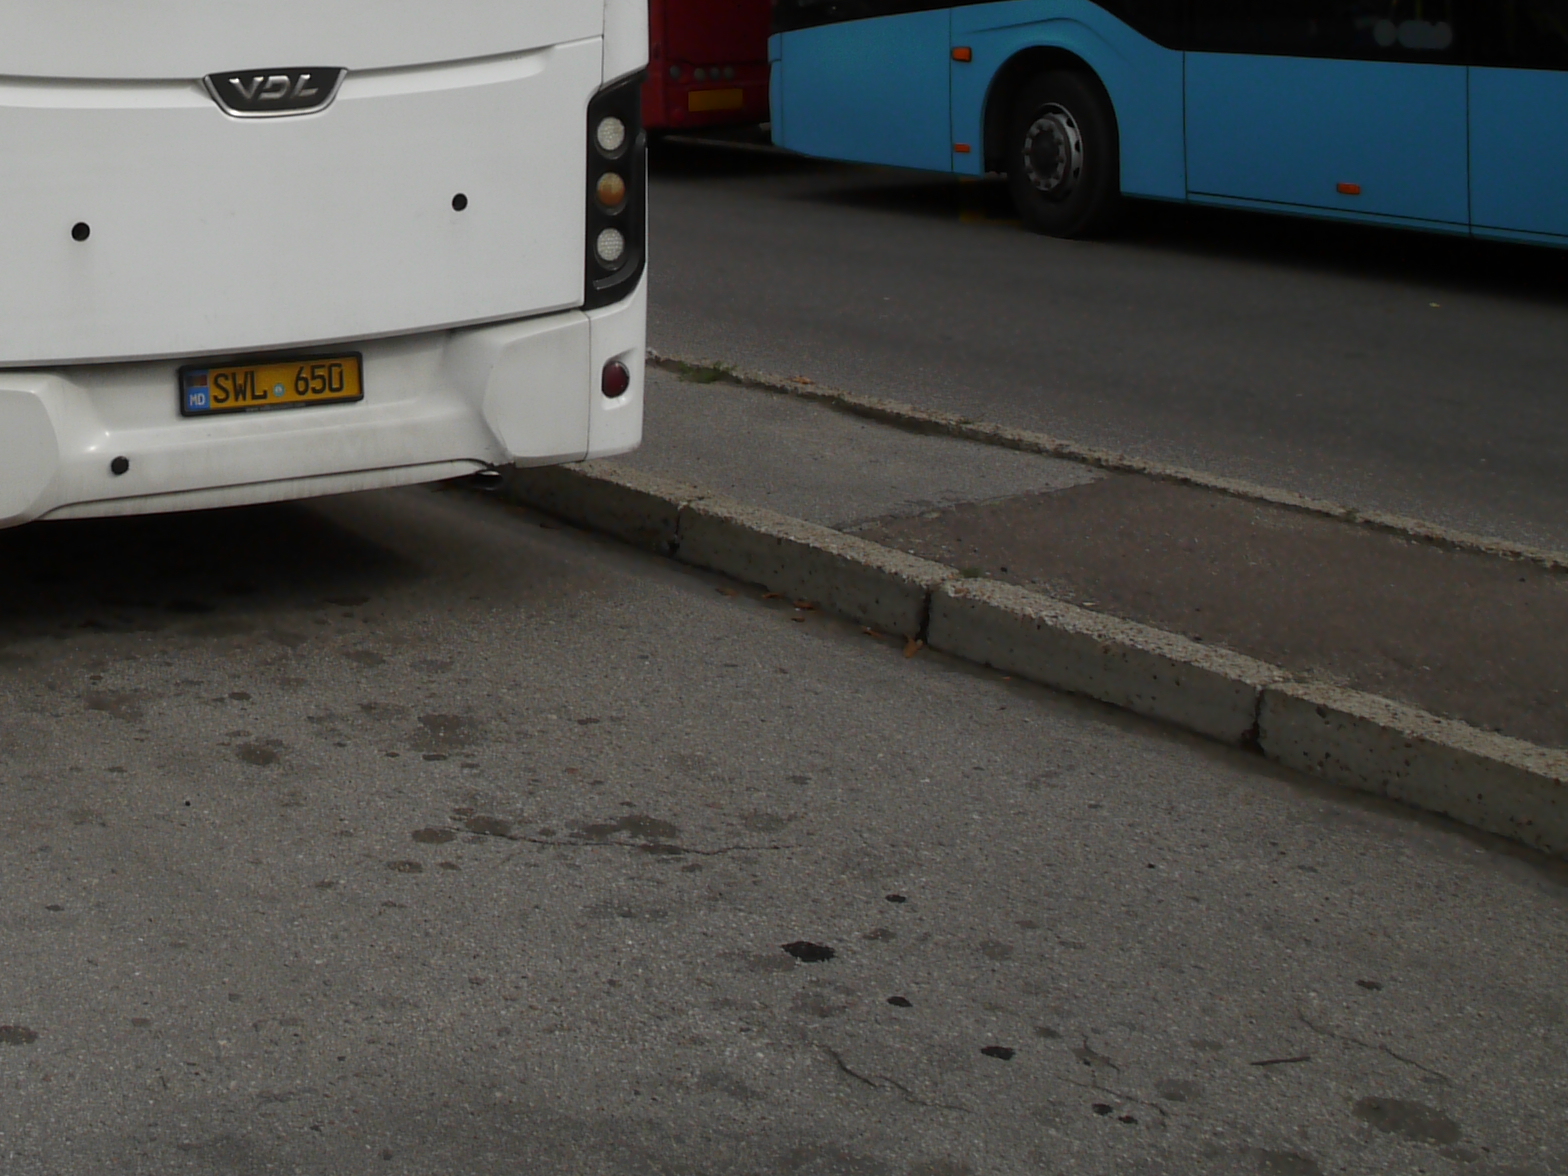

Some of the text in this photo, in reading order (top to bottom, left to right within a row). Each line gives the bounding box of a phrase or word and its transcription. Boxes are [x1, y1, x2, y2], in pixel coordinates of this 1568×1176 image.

[228, 73, 318, 101] VDL
[189, 363, 344, 406] MD SWL 650
